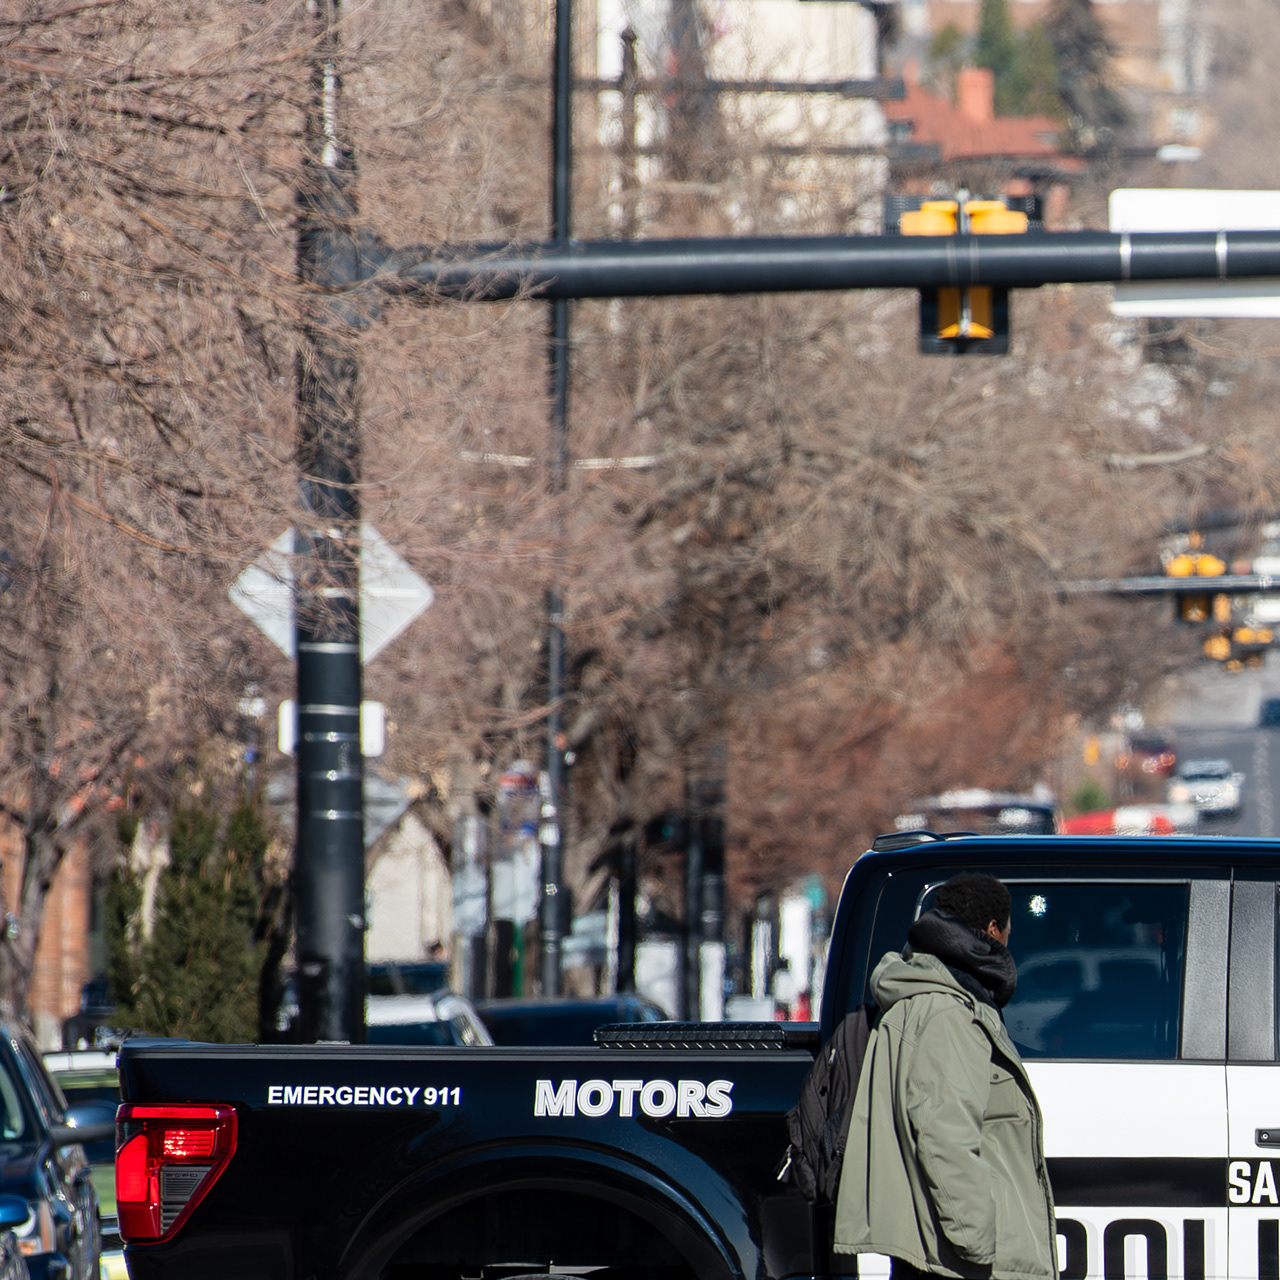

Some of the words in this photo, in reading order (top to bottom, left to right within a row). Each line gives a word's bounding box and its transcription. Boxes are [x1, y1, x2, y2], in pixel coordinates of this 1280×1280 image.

[267, 1085, 420, 1107] EMERGENCY
[423, 1086, 461, 1106] 911
[533, 1078, 734, 1119] MOTORS
